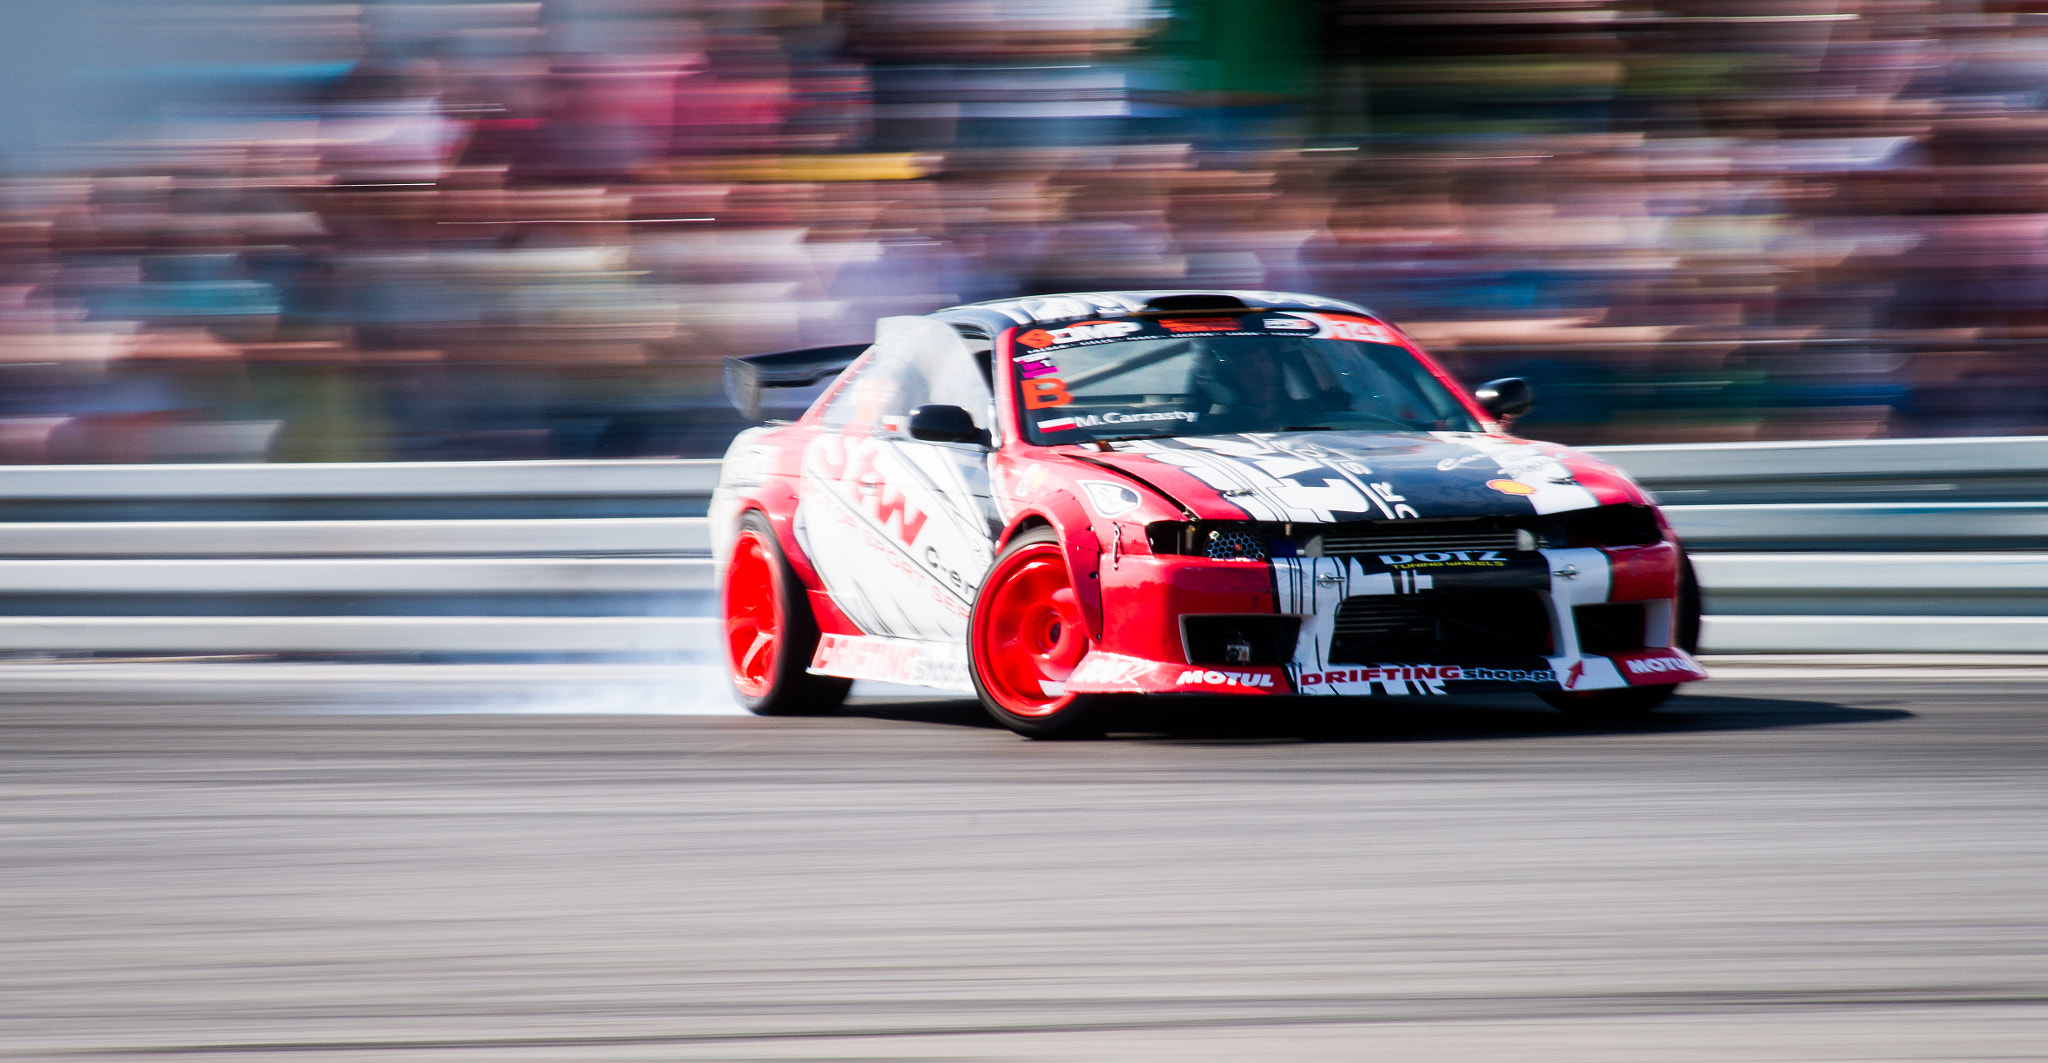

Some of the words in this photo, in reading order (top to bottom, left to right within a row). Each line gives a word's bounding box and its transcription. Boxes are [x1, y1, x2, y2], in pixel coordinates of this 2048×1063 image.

[1329, 318, 1392, 345] 14
[1021, 378, 1073, 410] B
[1378, 550, 1509, 565] DOTZ
[1391, 561, 1444, 570] TUNING
[1625, 657, 1692, 674] MOTU
[1176, 670, 1274, 687] MOTUL
